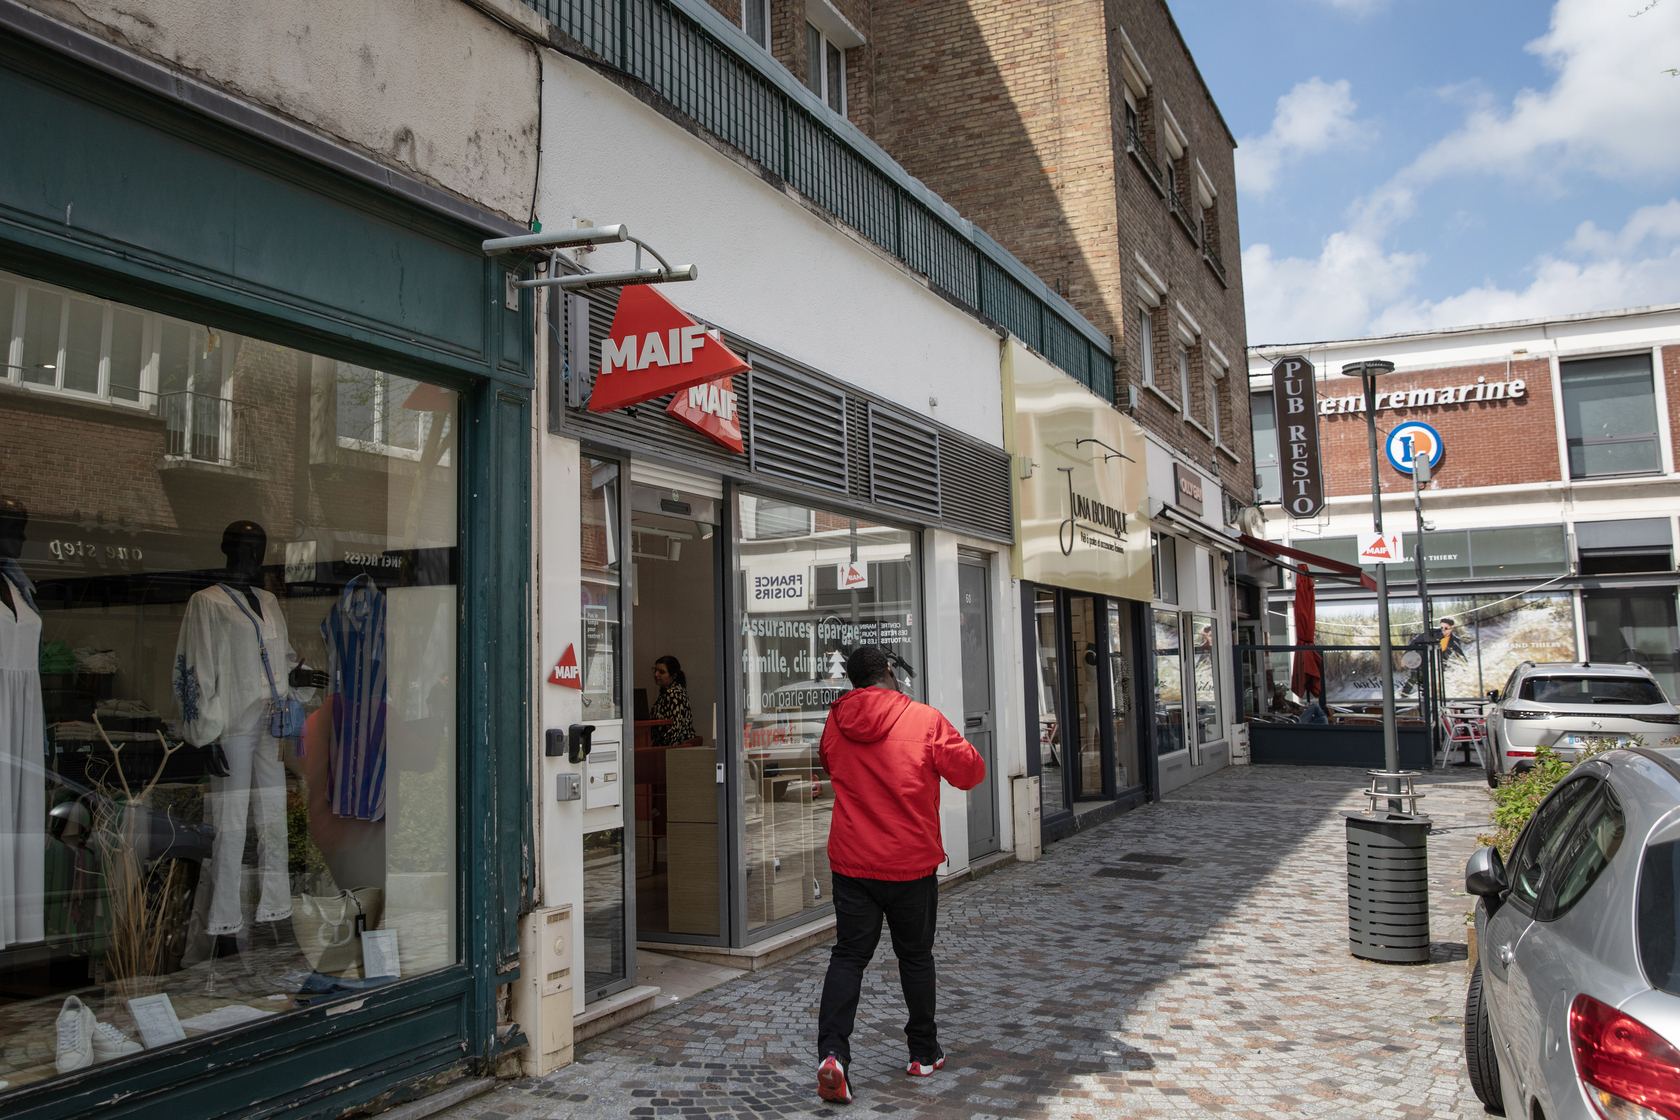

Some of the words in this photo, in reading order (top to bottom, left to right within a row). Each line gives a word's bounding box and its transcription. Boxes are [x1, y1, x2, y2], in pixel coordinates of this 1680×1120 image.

[601, 324, 708, 375] MAIF
[689, 383, 738, 421] MAIF
[1283, 361, 1305, 414] PUB
[1317, 376, 1526, 415] entremarine
[1288, 425, 1314, 514] RESTO
[1091, 500, 1129, 538] BOUTIQUE
[1366, 546, 1388, 555] MAIF
[555, 665, 579, 679] MAIF
[742, 649, 790, 678] famille,
[762, 692, 776, 708] on
[779, 685, 804, 712] parle
[806, 685, 819, 706] de
[744, 724, 786, 748] Entrez
